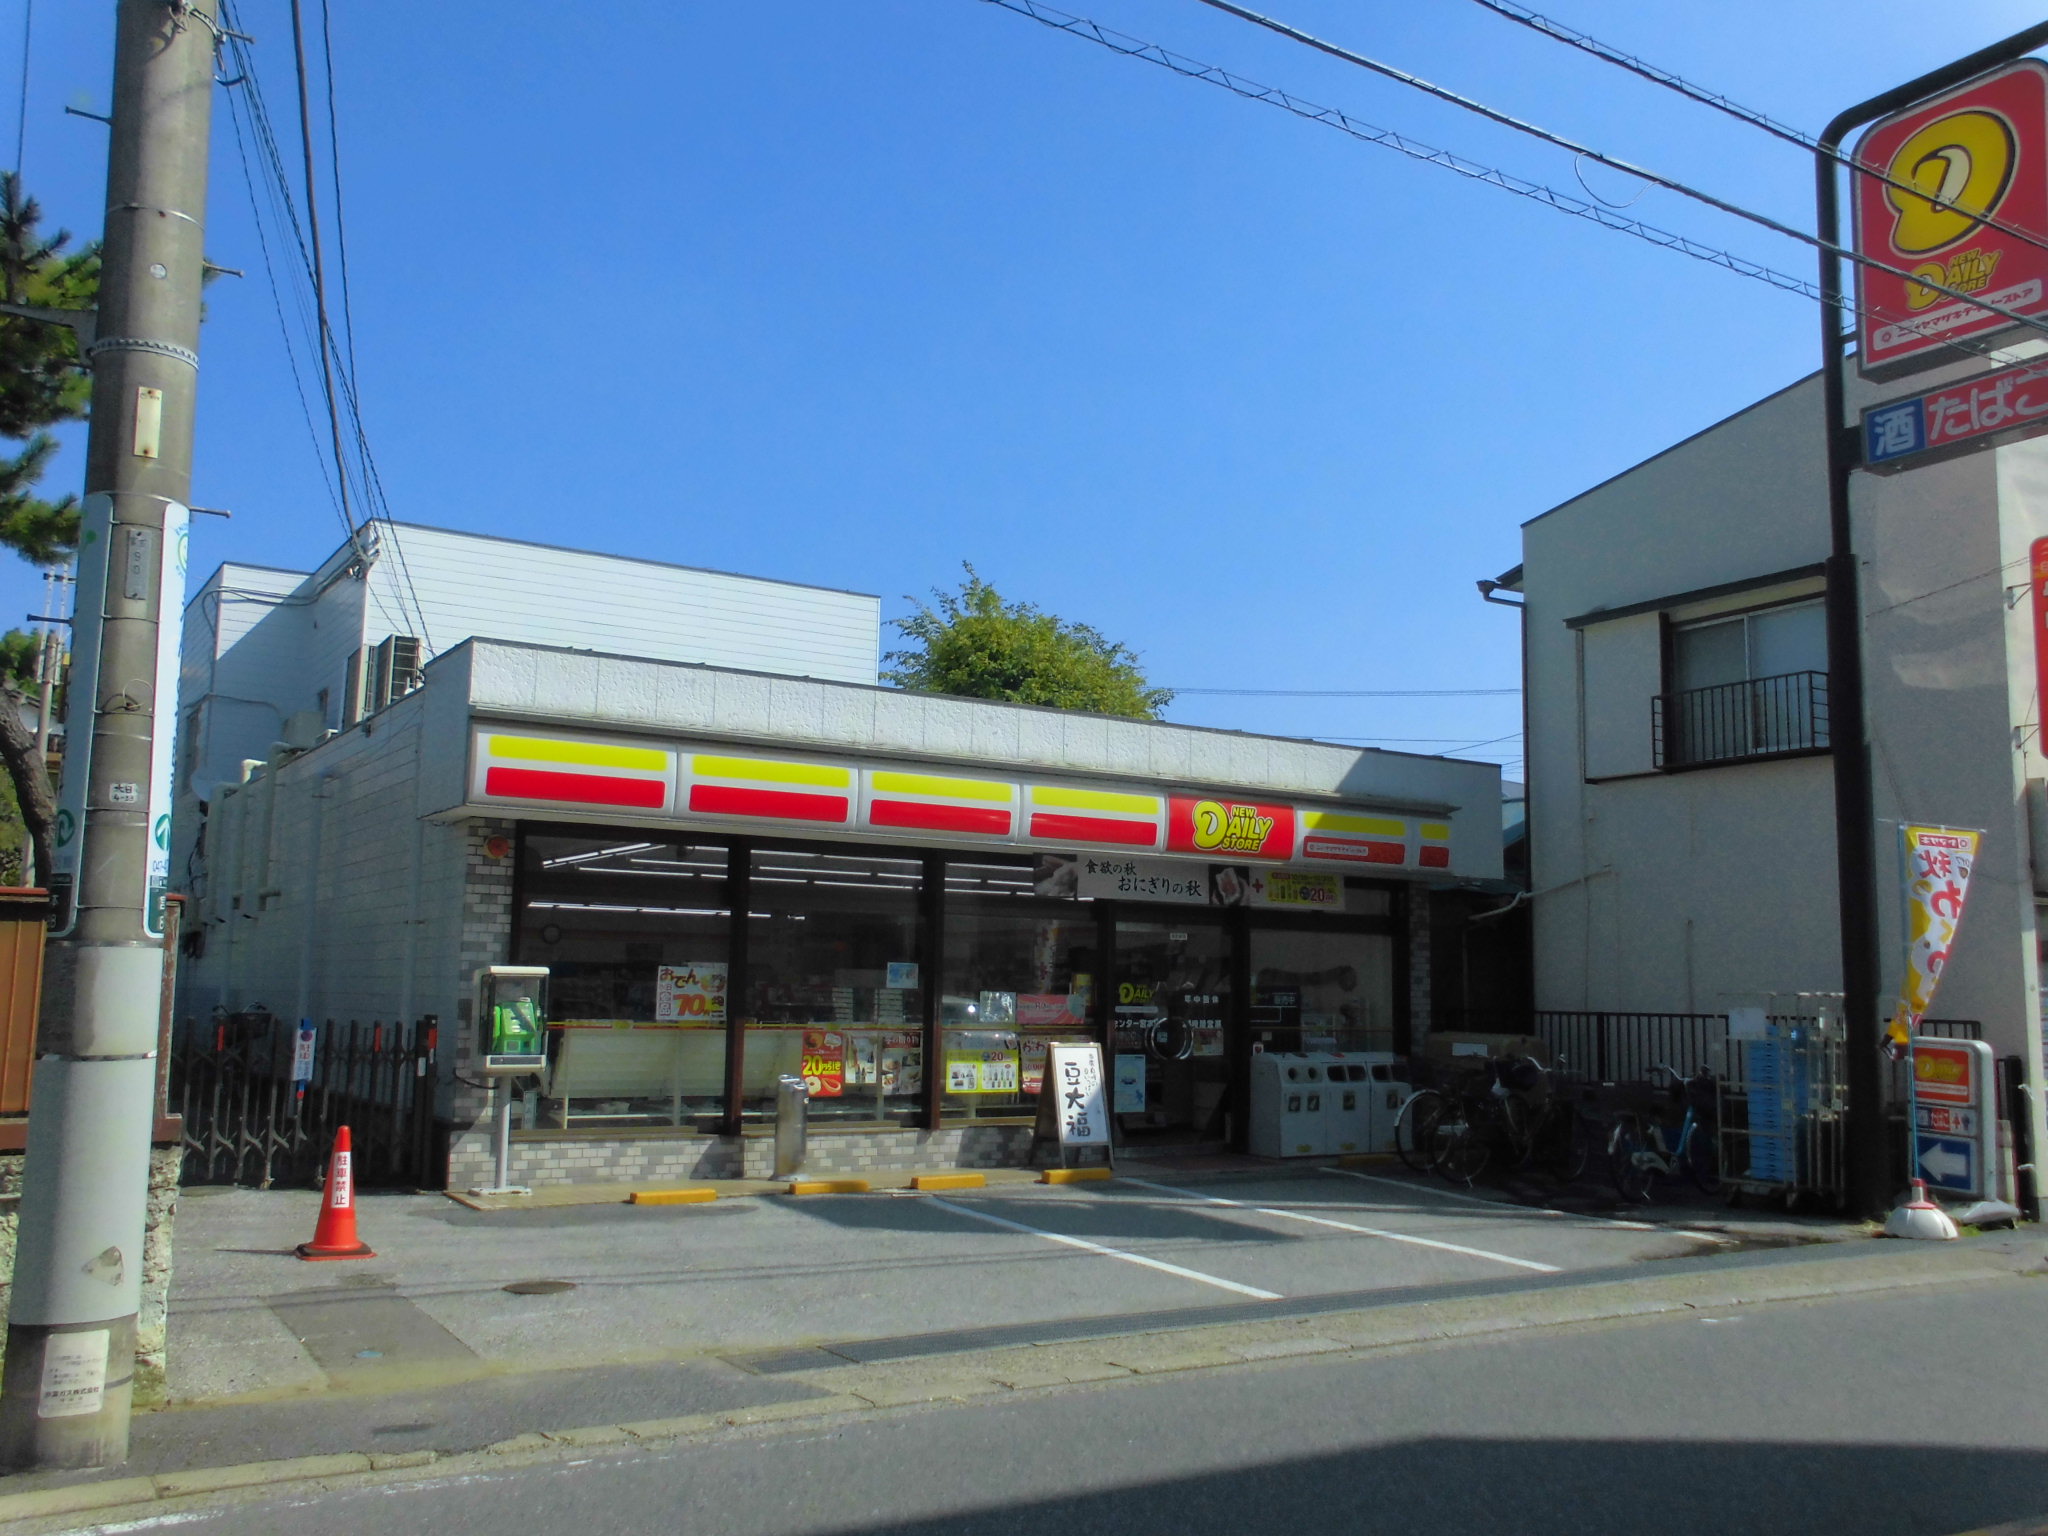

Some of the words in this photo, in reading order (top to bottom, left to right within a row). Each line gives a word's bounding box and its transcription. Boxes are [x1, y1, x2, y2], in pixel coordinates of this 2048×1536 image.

[1873, 404, 1915, 456] 酒
[1929, 366, 2048, 440] たばこ
[1193, 801, 1273, 849] DAILY
[1232, 806, 1256, 818] NEW
[1221, 838, 1261, 851] STORE
[1085, 858, 1137, 876] 食欲の秋
[1118, 875, 1202, 897] おにぎりの秋
[1064, 1061, 1091, 1137] 豆大福
[334, 1154, 348, 1206] 駐車禁止
